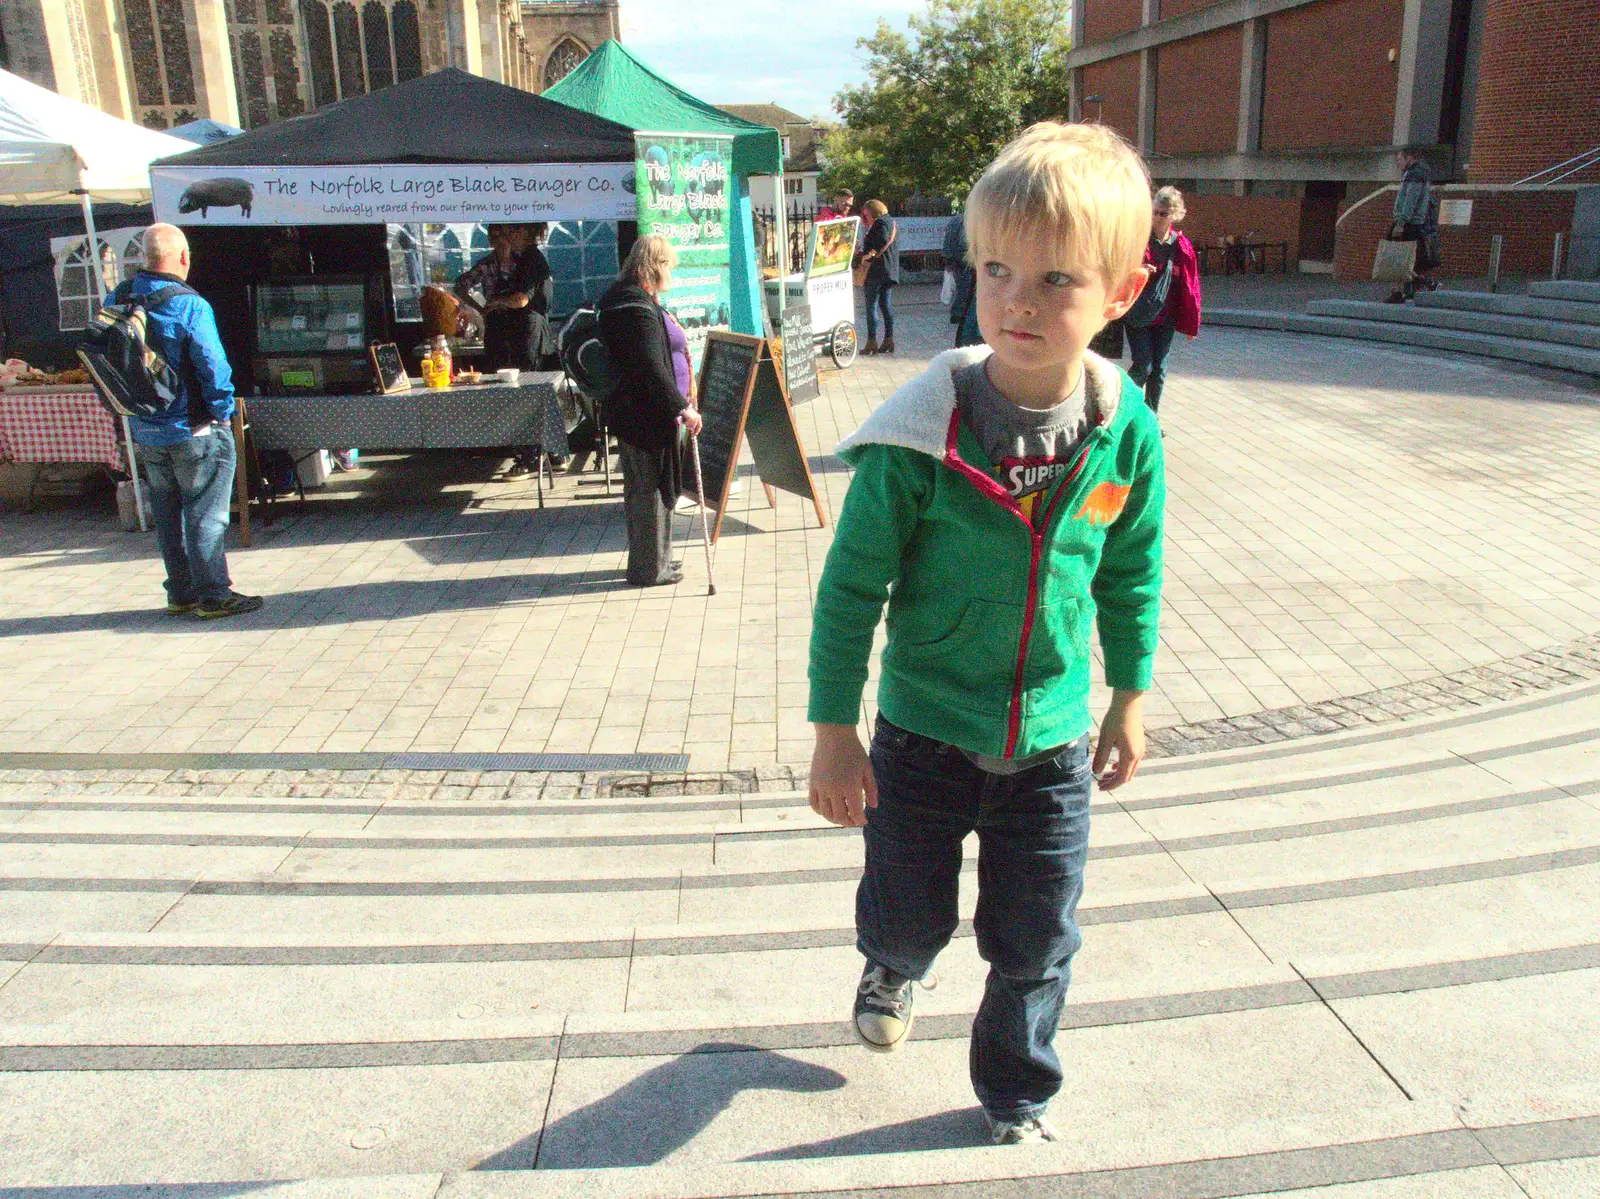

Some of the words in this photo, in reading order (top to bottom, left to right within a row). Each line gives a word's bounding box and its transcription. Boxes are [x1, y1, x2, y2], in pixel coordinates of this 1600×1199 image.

[644, 160, 671, 181] The
[677, 159, 729, 188] Norfolk
[264, 178, 298, 195] The
[310, 175, 385, 200] Norfolk
[390, 178, 445, 199] Large
[449, 176, 507, 193] Black
[511, 176, 583, 198] Banger
[587, 176, 615, 192] Co.
[322, 204, 373, 217] Lovingly
[376, 202, 408, 213] reared
[410, 202, 438, 214] from
[440, 204, 457, 212] our
[460, 201, 488, 214] farm
[490, 202, 501, 212] to
[504, 203, 529, 216] your
[531, 201, 556, 214] fork
[647, 192, 687, 216] Large
[686, 189, 728, 210] Black
[652, 222, 701, 245] Banger
[703, 220, 725, 238] Co.
[789, 287, 804, 297] MILK
[812, 281, 834, 295] PROPER
[834, 279, 848, 291] MILK
